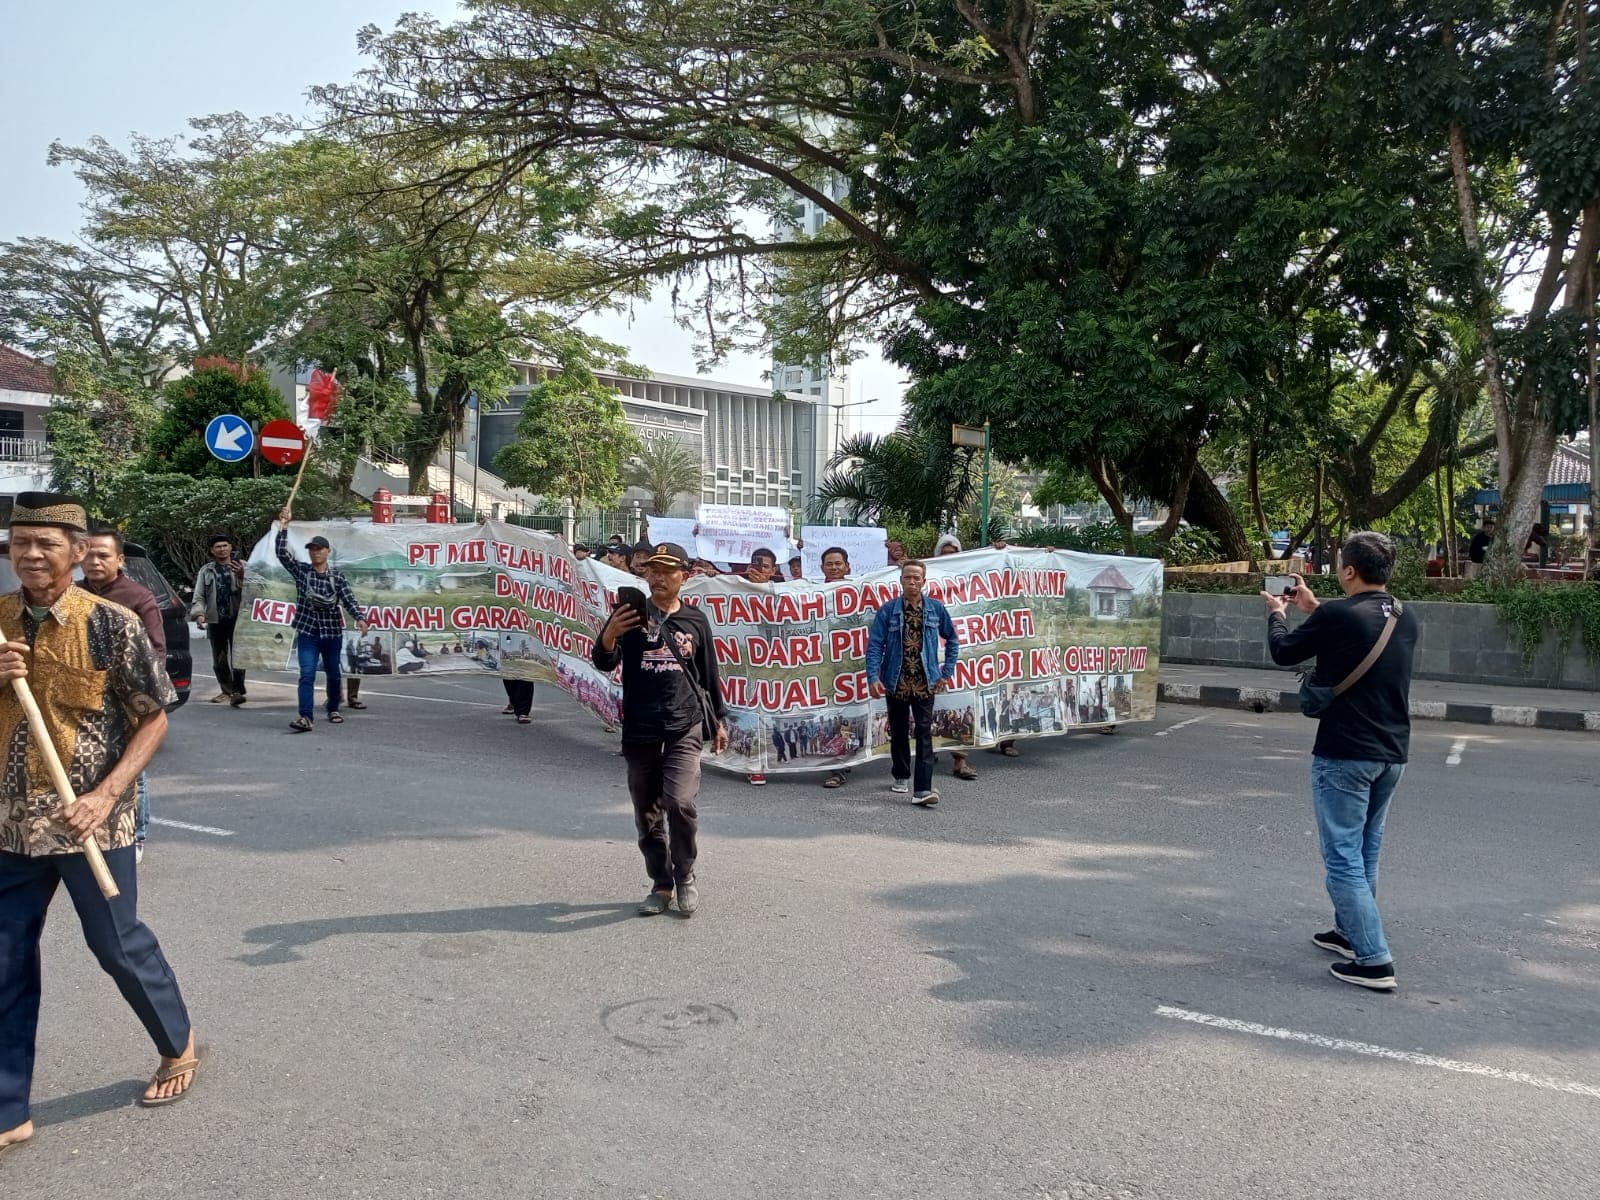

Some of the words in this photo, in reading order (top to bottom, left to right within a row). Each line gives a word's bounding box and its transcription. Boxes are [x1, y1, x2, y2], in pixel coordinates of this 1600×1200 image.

[639, 428, 674, 441] AGUNG
[408, 542, 440, 567] PT
[447, 540, 487, 565] MII
[491, 540, 544, 574] TELAH
[705, 593, 825, 625] TANAH
[834, 582, 902, 617] DAN
[927, 568, 1032, 606] ANAMAN
[1033, 570, 1066, 598] KAMI
[533, 584, 578, 620] KAMI
[746, 634, 822, 667] DARI
[938, 609, 1035, 650] ERKAIT
[748, 678, 826, 712] JUAL
[997, 650, 1022, 681] DI
[1064, 646, 1104, 672] OLEH
[1107, 646, 1127, 672] PT
[1127, 645, 1148, 672] MII
